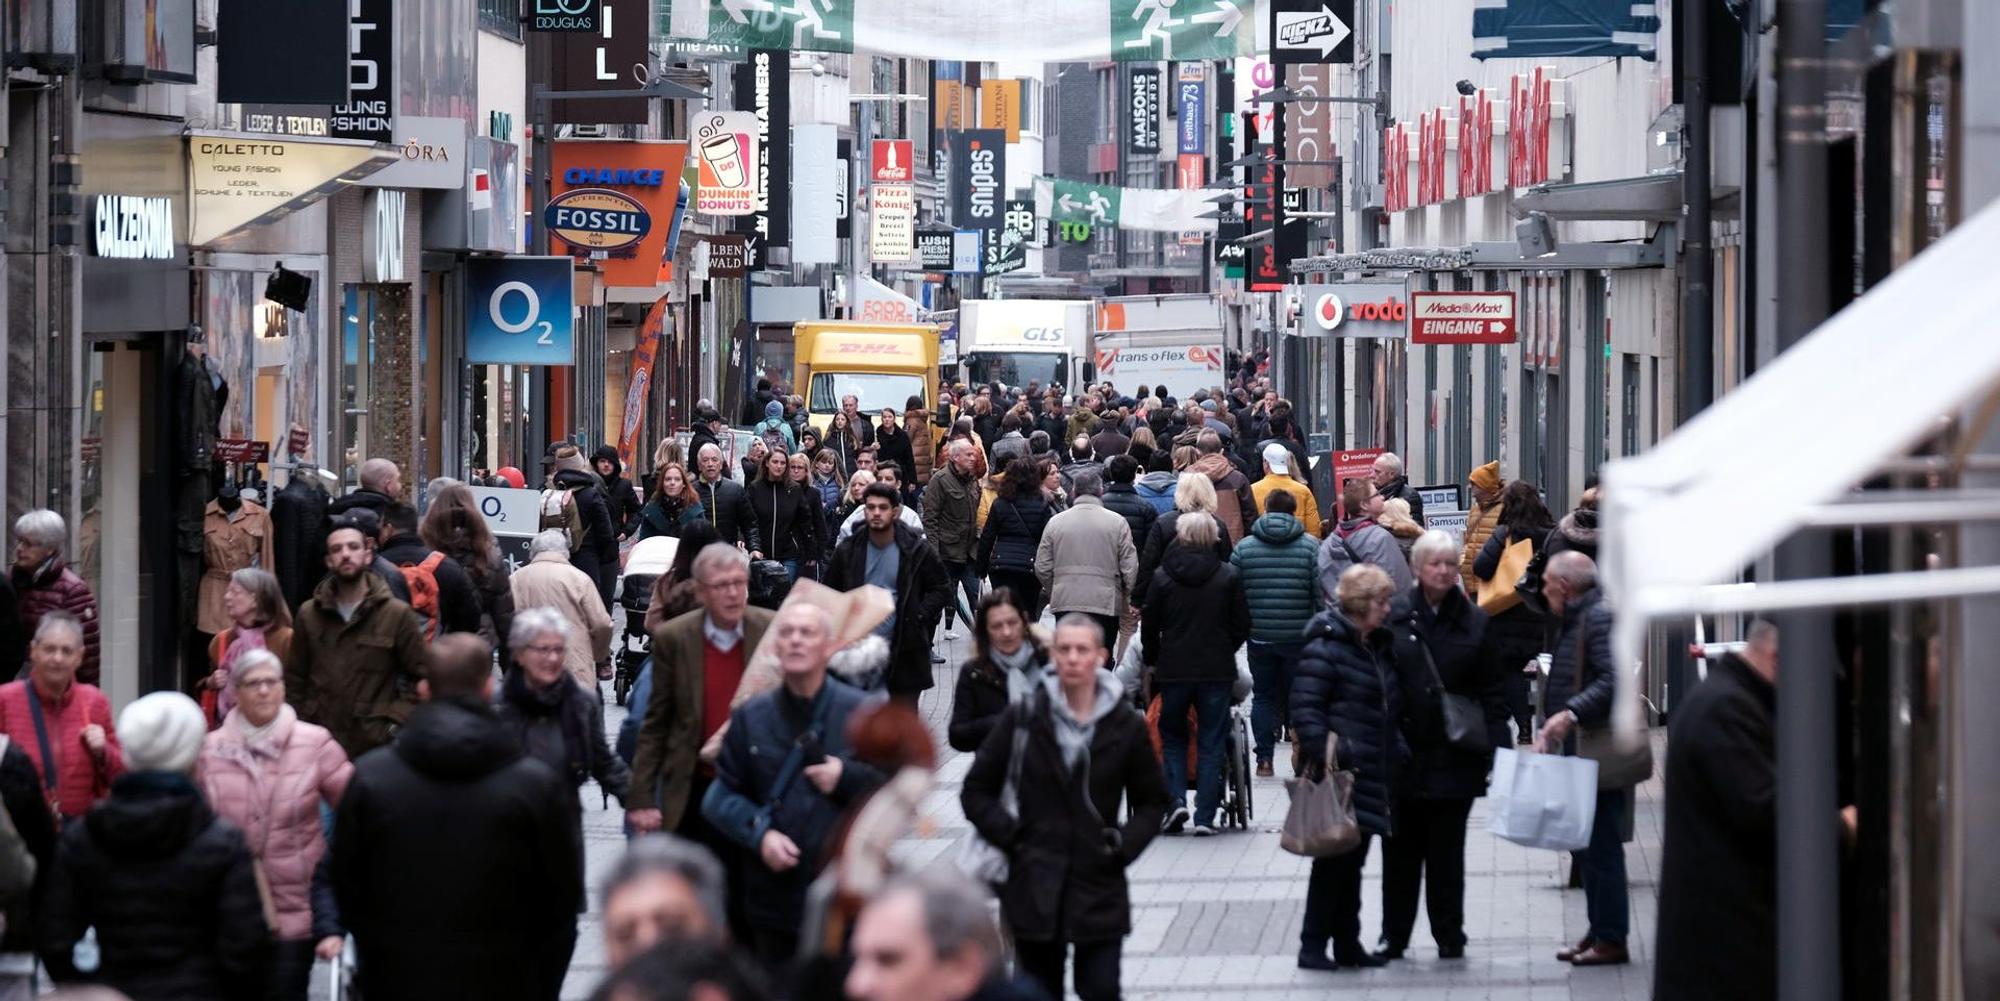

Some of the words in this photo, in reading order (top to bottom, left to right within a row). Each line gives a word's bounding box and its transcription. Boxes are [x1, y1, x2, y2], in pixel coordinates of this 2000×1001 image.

[536, 16, 591, 29] DOUGLAS
[1150, 75, 1158, 121] MONDE
[1182, 84, 1199, 102] 73
[335, 101, 387, 114] OUNG
[1133, 74, 1147, 147] MAISONS
[246, 115, 273, 132] LEDER
[277, 116, 284, 133] &
[286, 116, 327, 135] TEXTILIEN
[331, 117, 392, 131] SHION
[1150, 131, 1157, 147] DU
[201, 143, 284, 156] CALETTO
[212, 165, 241, 173] YOUNG
[245, 165, 281, 173] FASHION
[564, 167, 665, 187] CHANGE
[970, 149, 999, 218] snipes
[699, 189, 753, 200] DUNKIN'
[876, 187, 908, 197] Pizza
[566, 194, 633, 209] AUTHENTIC
[699, 200, 751, 210] DONUTS
[96, 194, 174, 259] CALZEDONIA
[556, 208, 641, 232] FOSSIL
[376, 188, 406, 284] ONLY
[1060, 221, 1090, 243] TO
[918, 236, 951, 246] LUSH
[711, 245, 742, 256] LBEN
[919, 245, 951, 255] FRESH
[863, 300, 906, 313] FOOD
[1023, 327, 1064, 342] GLS
[1423, 320, 1484, 335] EINGANG
[839, 343, 900, 354] DHL
